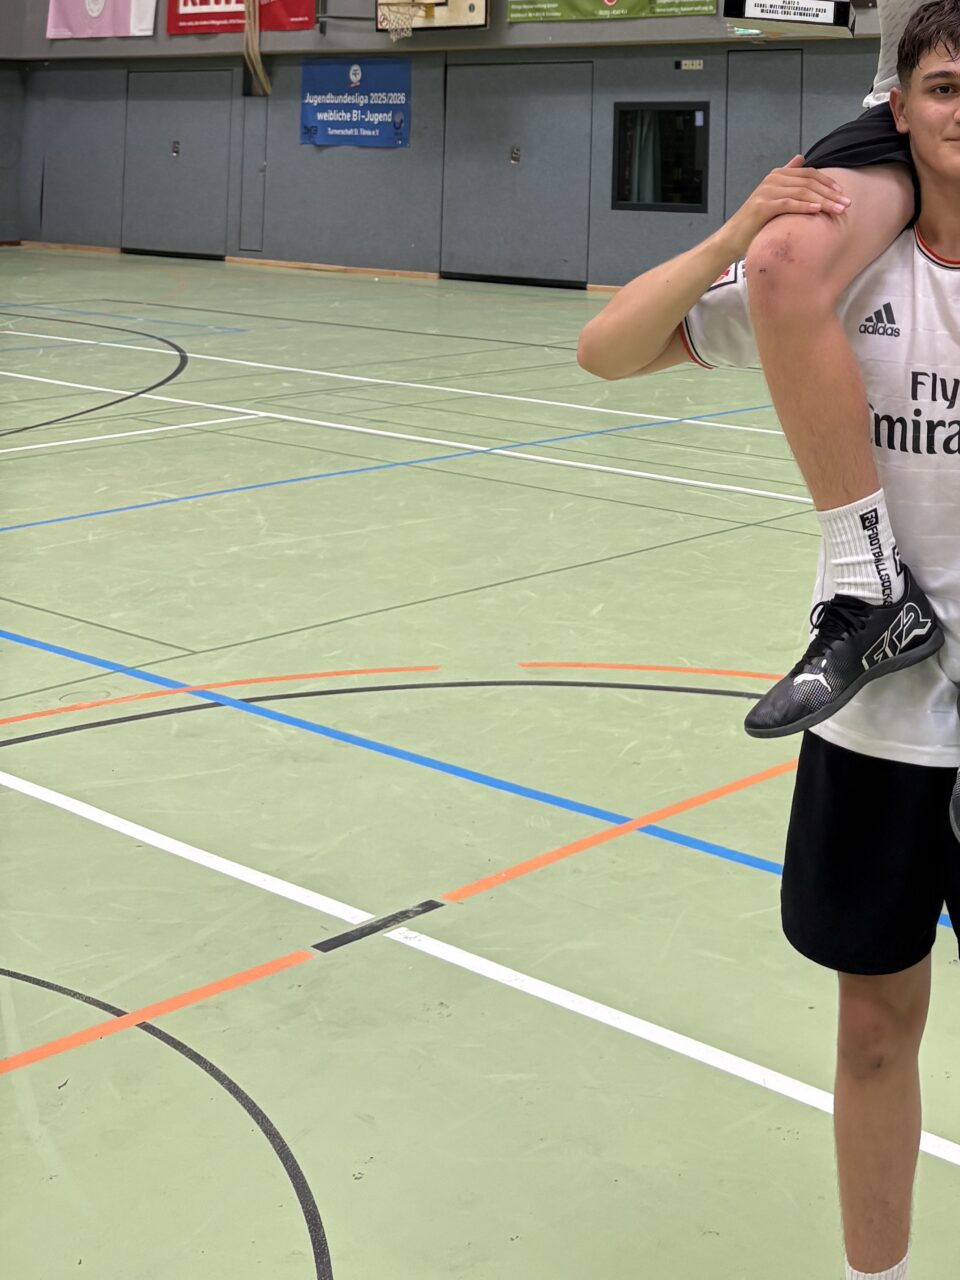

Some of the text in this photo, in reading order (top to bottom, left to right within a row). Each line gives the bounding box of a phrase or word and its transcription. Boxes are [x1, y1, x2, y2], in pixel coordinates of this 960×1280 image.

[304, 92, 406, 106] Jugendbundesliga 2025/2026
[316, 110, 392, 124] weibliche B1-Jugend
[859, 322, 901, 338] adidas
[911, 371, 960, 409] Fly
